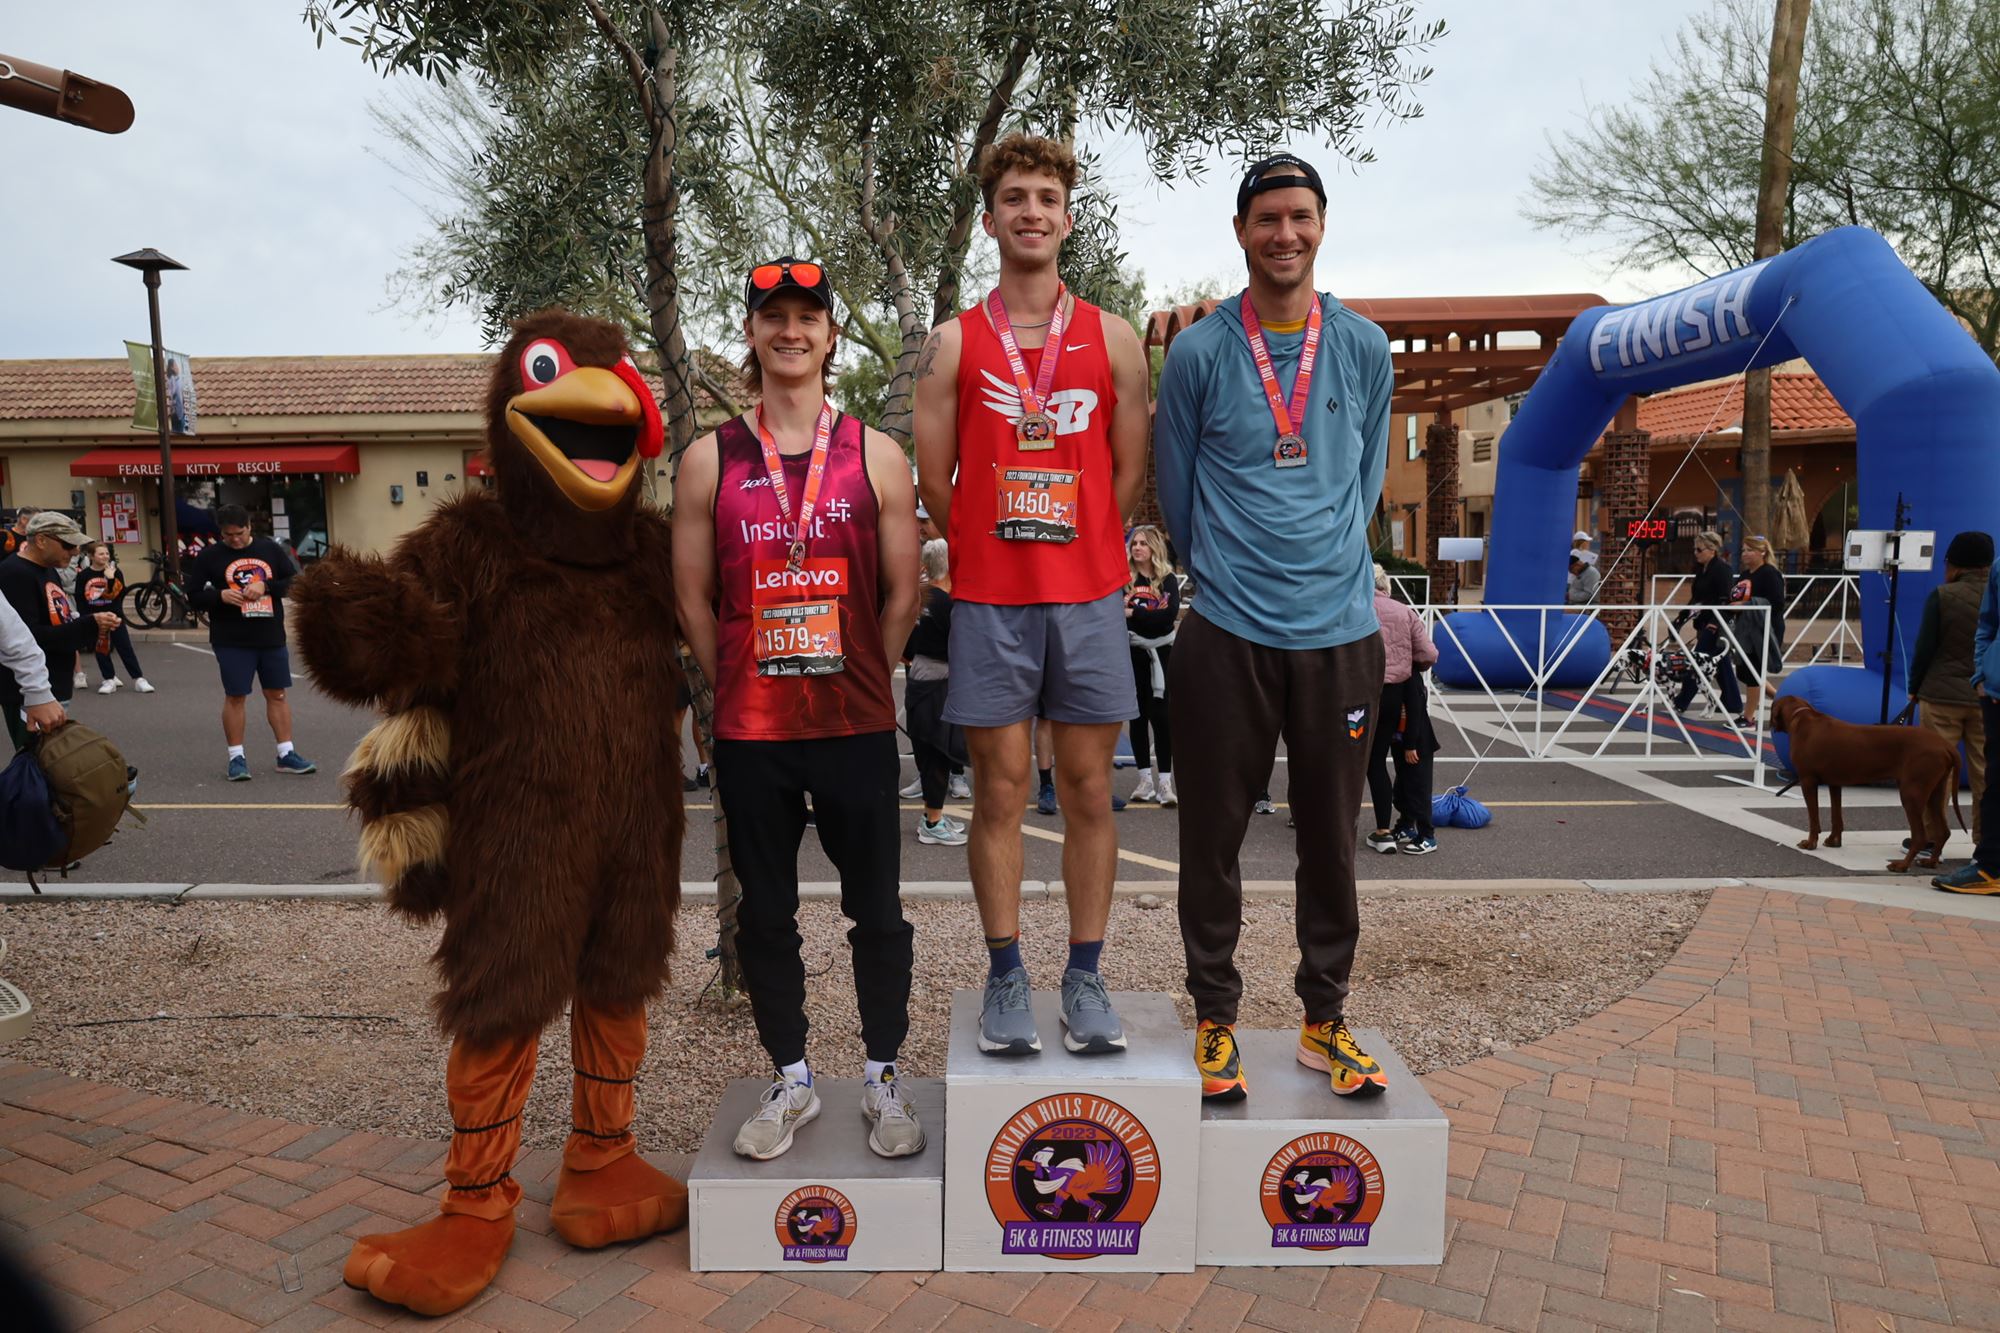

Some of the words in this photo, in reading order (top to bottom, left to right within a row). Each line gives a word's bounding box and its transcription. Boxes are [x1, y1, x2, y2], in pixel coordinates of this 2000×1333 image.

[1589, 275, 1753, 372] FINISH
[1305, 327, 1320, 346] TROT
[999, 330, 1019, 358] TURKEY
[1010, 356, 1026, 376] TROT
[1249, 334, 1268, 363] TURKEY
[1300, 345, 1316, 375] TURKEY
[1258, 361, 1275, 382] TROT
[815, 435, 829, 453] TROT
[118, 463, 164, 475] FEARLE
[186, 463, 220, 474] KITTY
[237, 462, 281, 473] RESCUE
[770, 469, 785, 490] TROT
[1006, 490, 1050, 515] 1450
[755, 569, 840, 590] Lenovo
[764, 626, 809, 652] 1579
[989, 1112, 1039, 1182] FOUNTAIN
[1037, 1097, 1082, 1123] HILLS
[1089, 1099, 1144, 1144] TURKEY
[1131, 1143, 1156, 1183] TROT
[1051, 1127, 1097, 1140] 2023
[1263, 1146, 1298, 1196] FOUNTAIN
[1298, 1135, 1329, 1154] HILLS
[1333, 1136, 1372, 1169] TURKEY
[1363, 1167, 1381, 1195] TROT
[1307, 1157, 1340, 1165] 2023
[776, 1193, 800, 1227] FOUNTAIN
[799, 1186, 820, 1199] HILLS
[822, 1187, 849, 1211] TURKEY
[842, 1208, 855, 1227] TROT
[1009, 1228, 1027, 1248] 5K
[1028, 1228, 1038, 1247] &
[1042, 1228, 1093, 1248] FITNESS
[1097, 1228, 1135, 1248] WALK
[1277, 1228, 1289, 1243] 5K
[1290, 1228, 1298, 1242] &
[1300, 1228, 1337, 1242] FITNESS
[1339, 1228, 1366, 1242] WALK
[786, 1248, 795, 1258] 5K
[795, 1248, 801, 1257] &
[801, 1248, 826, 1258] FITNESS
[827, 1248, 846, 1258] WALK
